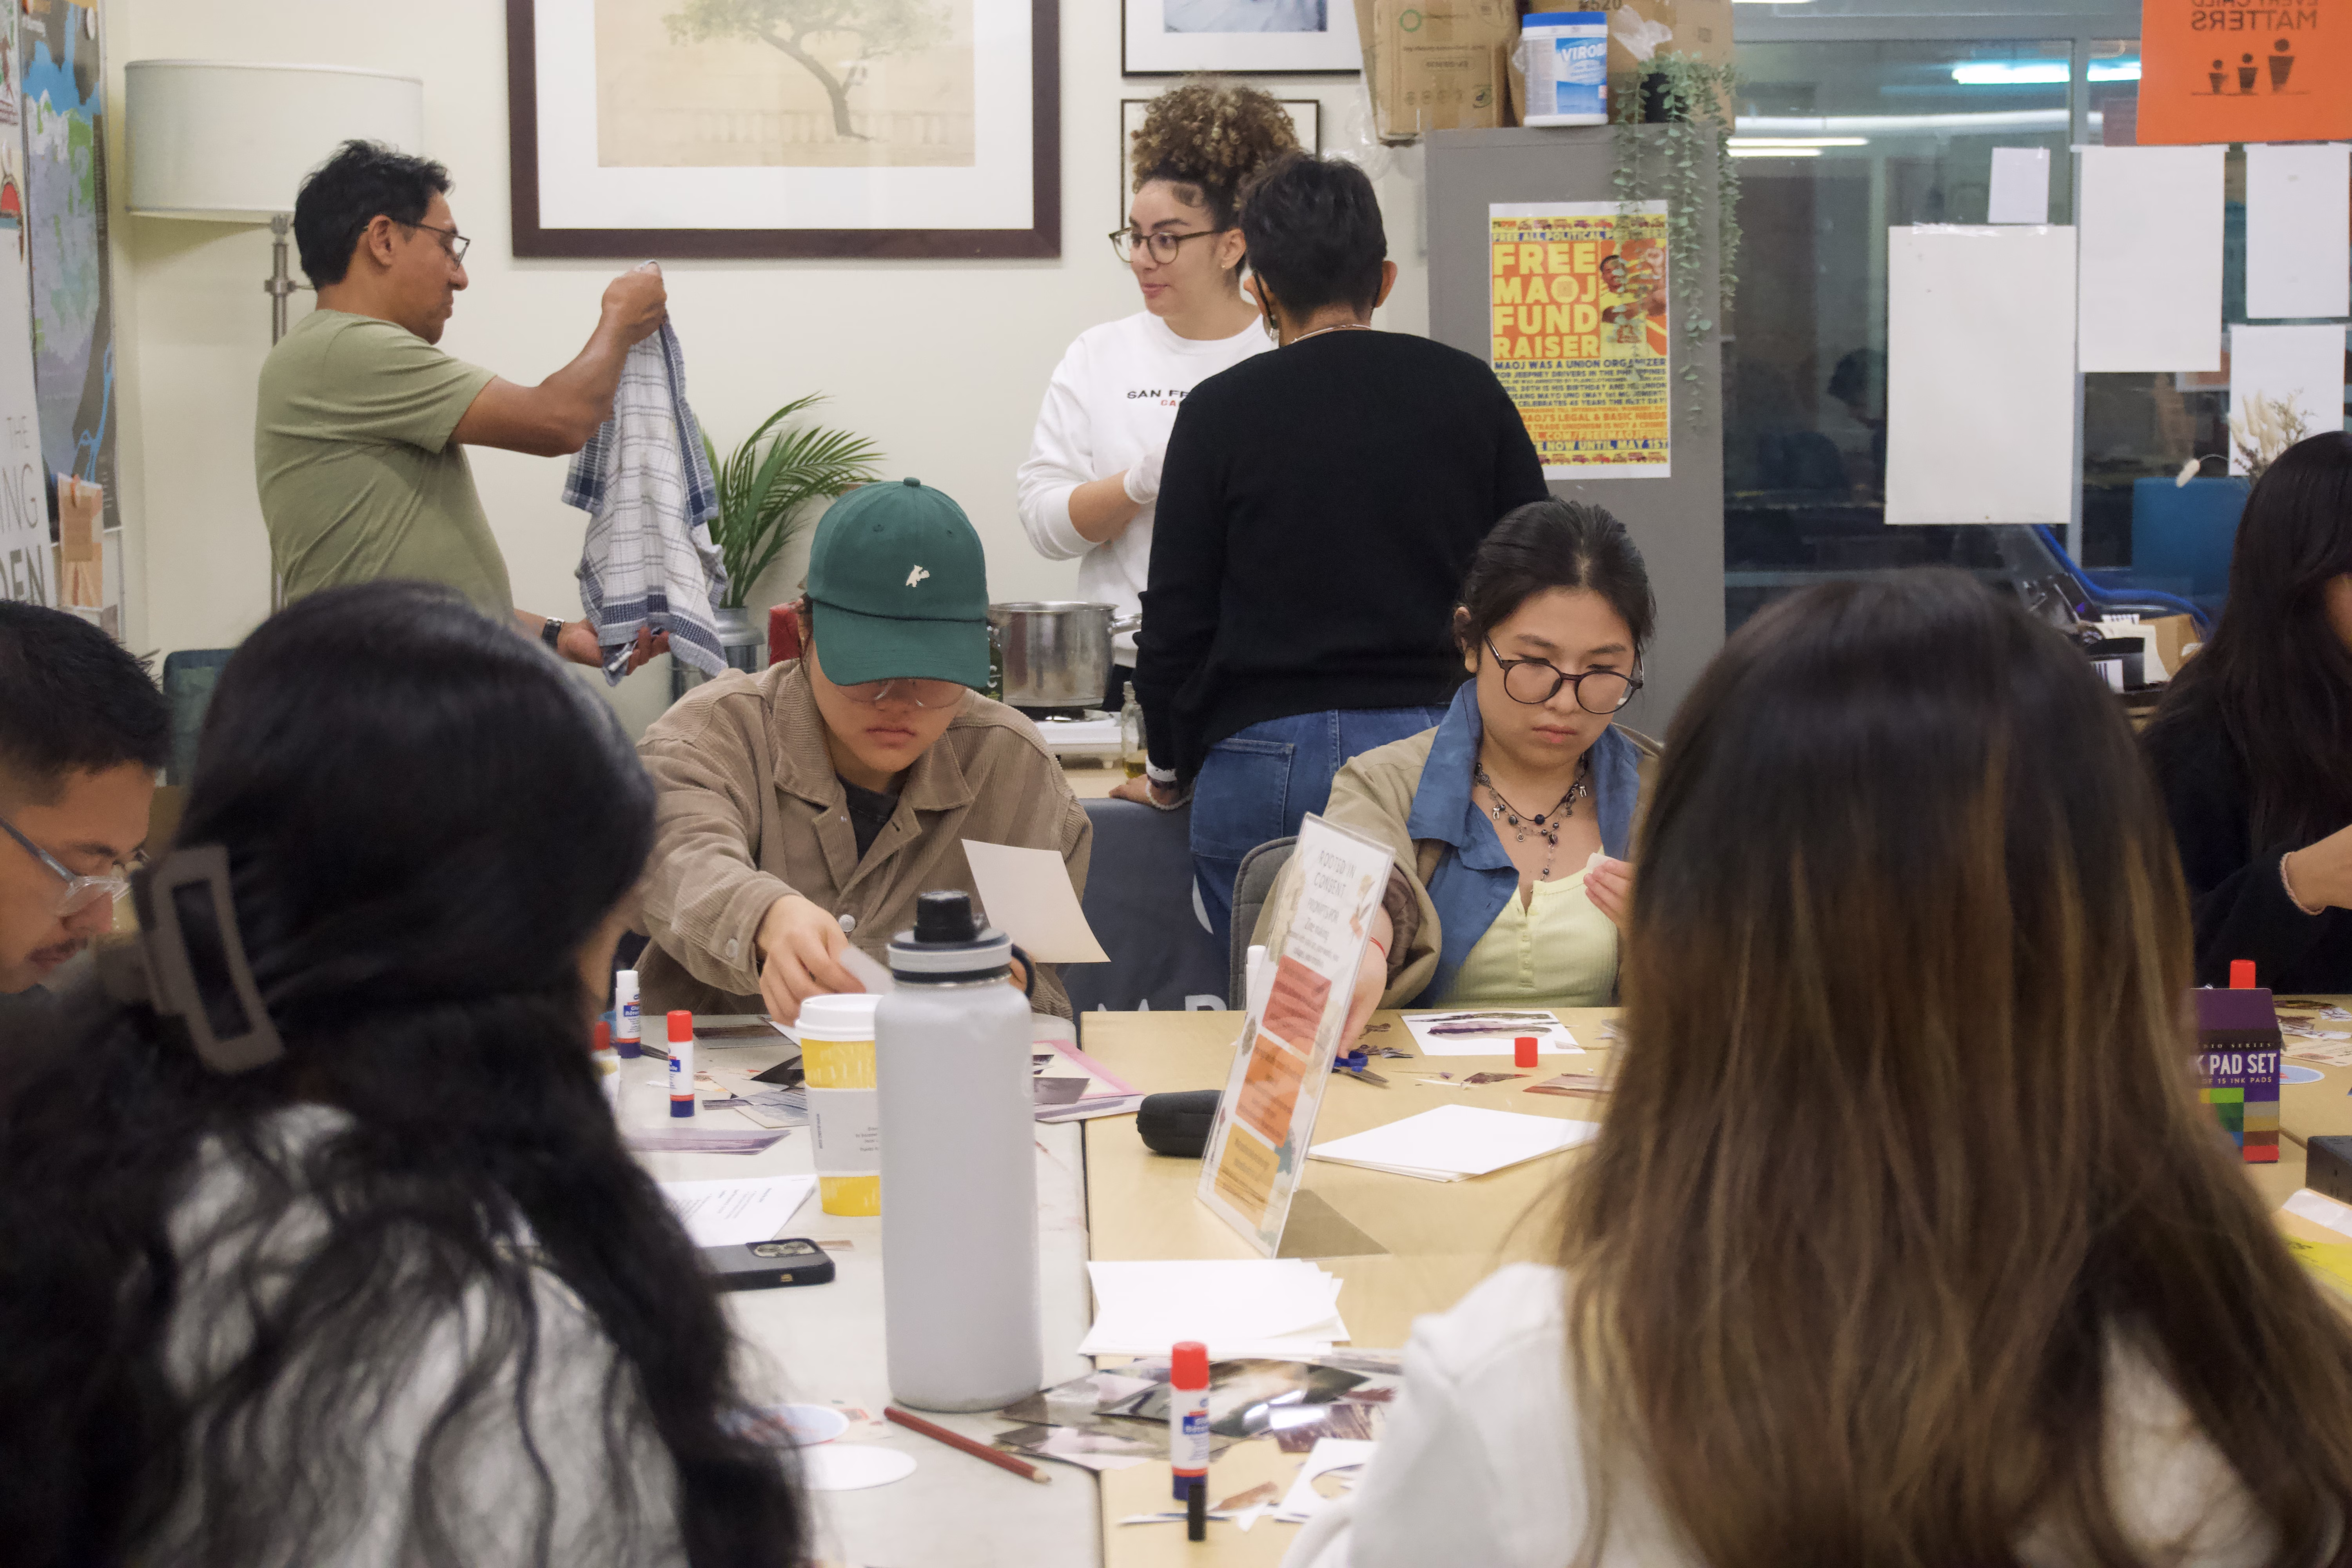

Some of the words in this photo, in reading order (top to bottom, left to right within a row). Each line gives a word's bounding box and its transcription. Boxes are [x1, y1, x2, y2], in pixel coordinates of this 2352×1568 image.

[1492, 243, 1597, 274] FREE
[1493, 275, 1597, 304] MAOJ
[1493, 305, 1597, 335] FUND
[1493, 334, 1599, 359] RAISER
[1495, 361, 1526, 370] MAOJ
[1530, 361, 1552, 369] WAS
[1556, 360, 1563, 368] A
[1566, 360, 1600, 368] UNION
[1127, 390, 1161, 399] SAN
[1547, 441, 1575, 451] NOW
[1617, 440, 1643, 449] MAY
[1318, 850, 1346, 874] ROOTED
[1314, 872, 1347, 898] CONSENT
[2209, 1054, 2242, 1075] PAD
[2247, 1053, 2277, 1074] SET
